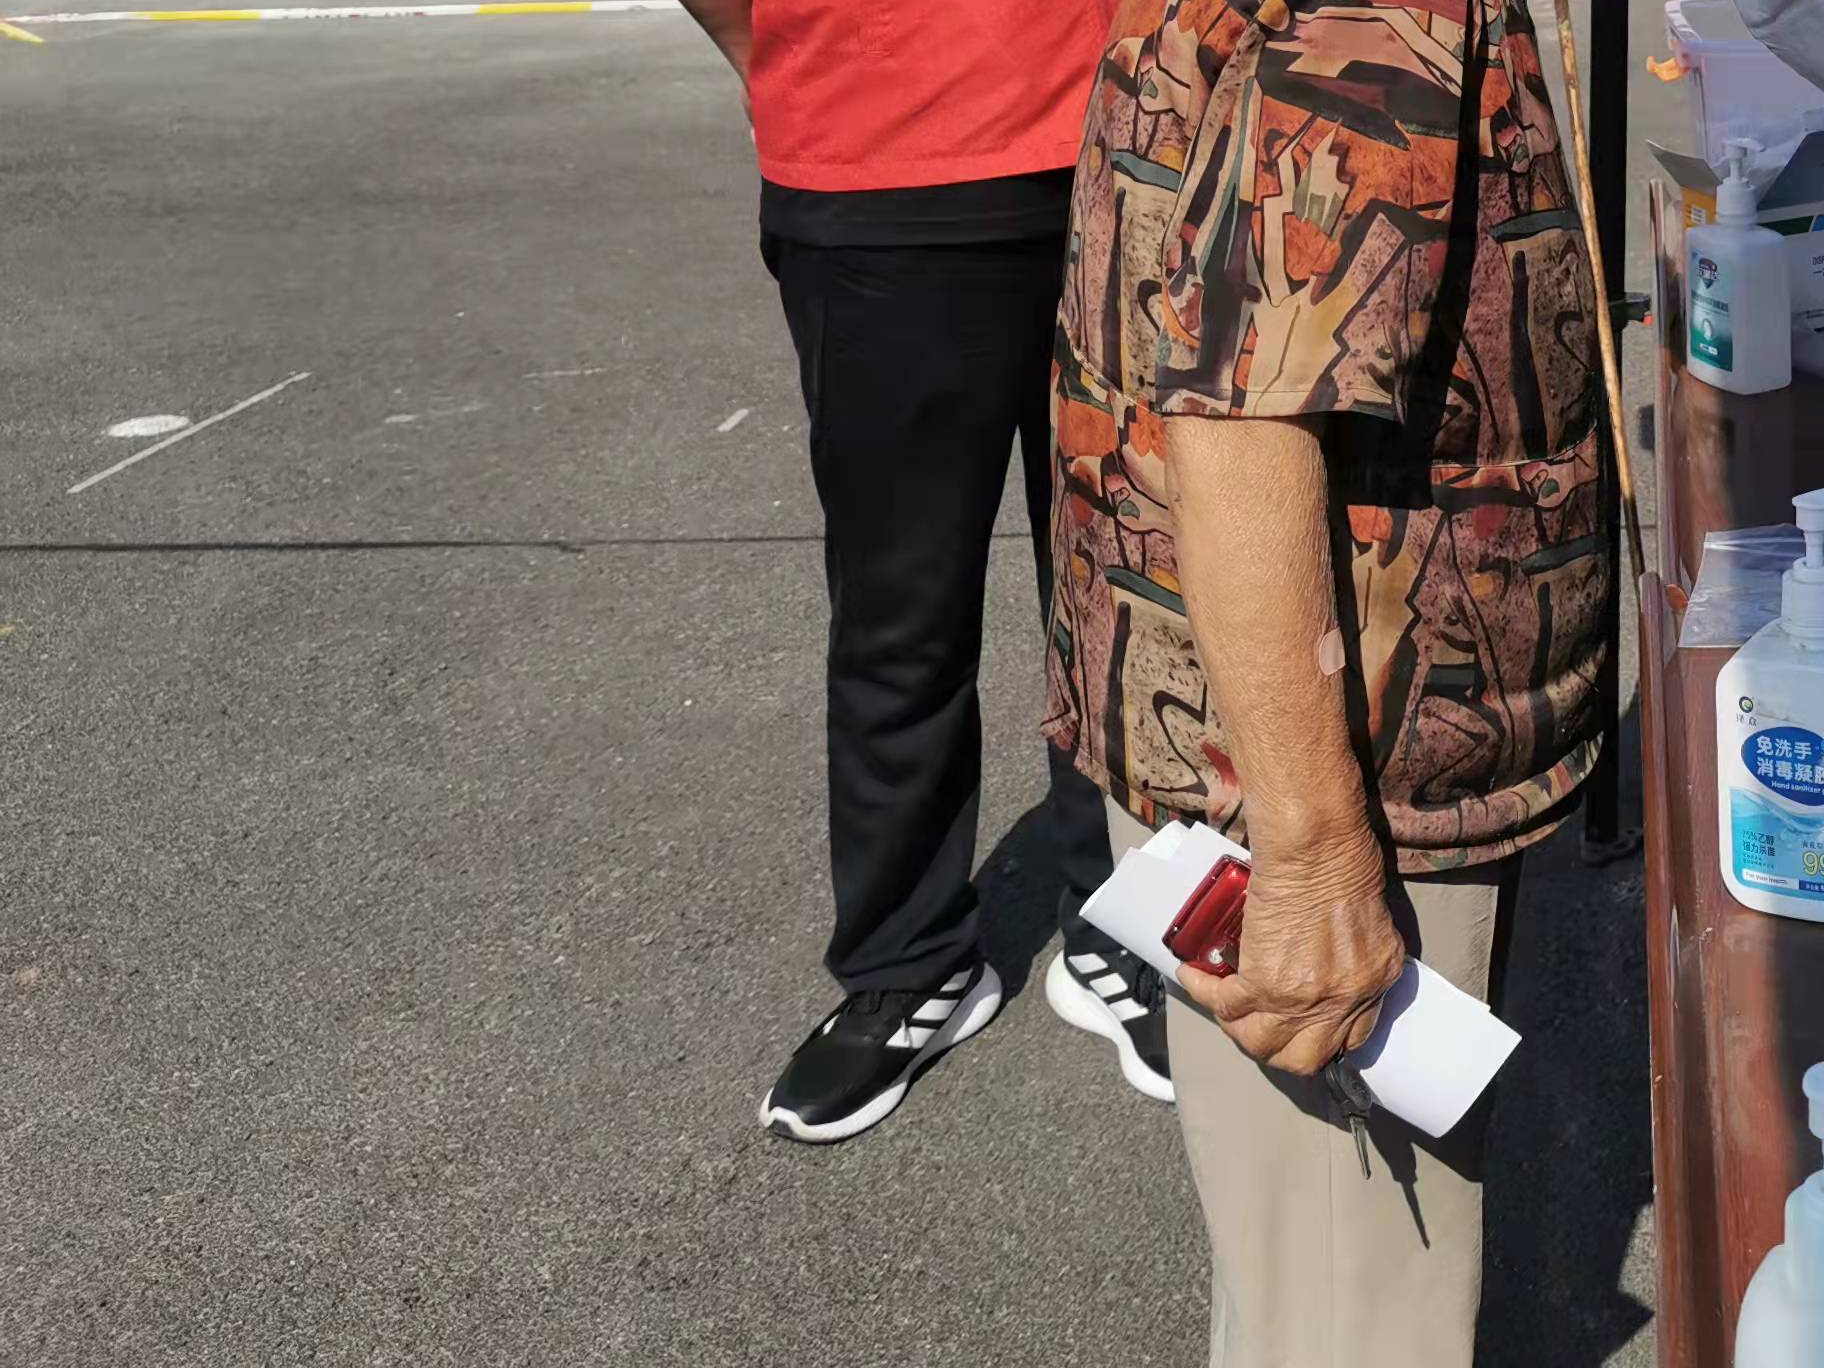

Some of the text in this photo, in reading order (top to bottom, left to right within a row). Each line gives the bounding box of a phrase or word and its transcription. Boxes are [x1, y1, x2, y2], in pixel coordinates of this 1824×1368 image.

[1756, 735, 1812, 760] 免洗手
[1771, 780, 1790, 790] Hand
[1791, 783, 1821, 794] sanitizer
